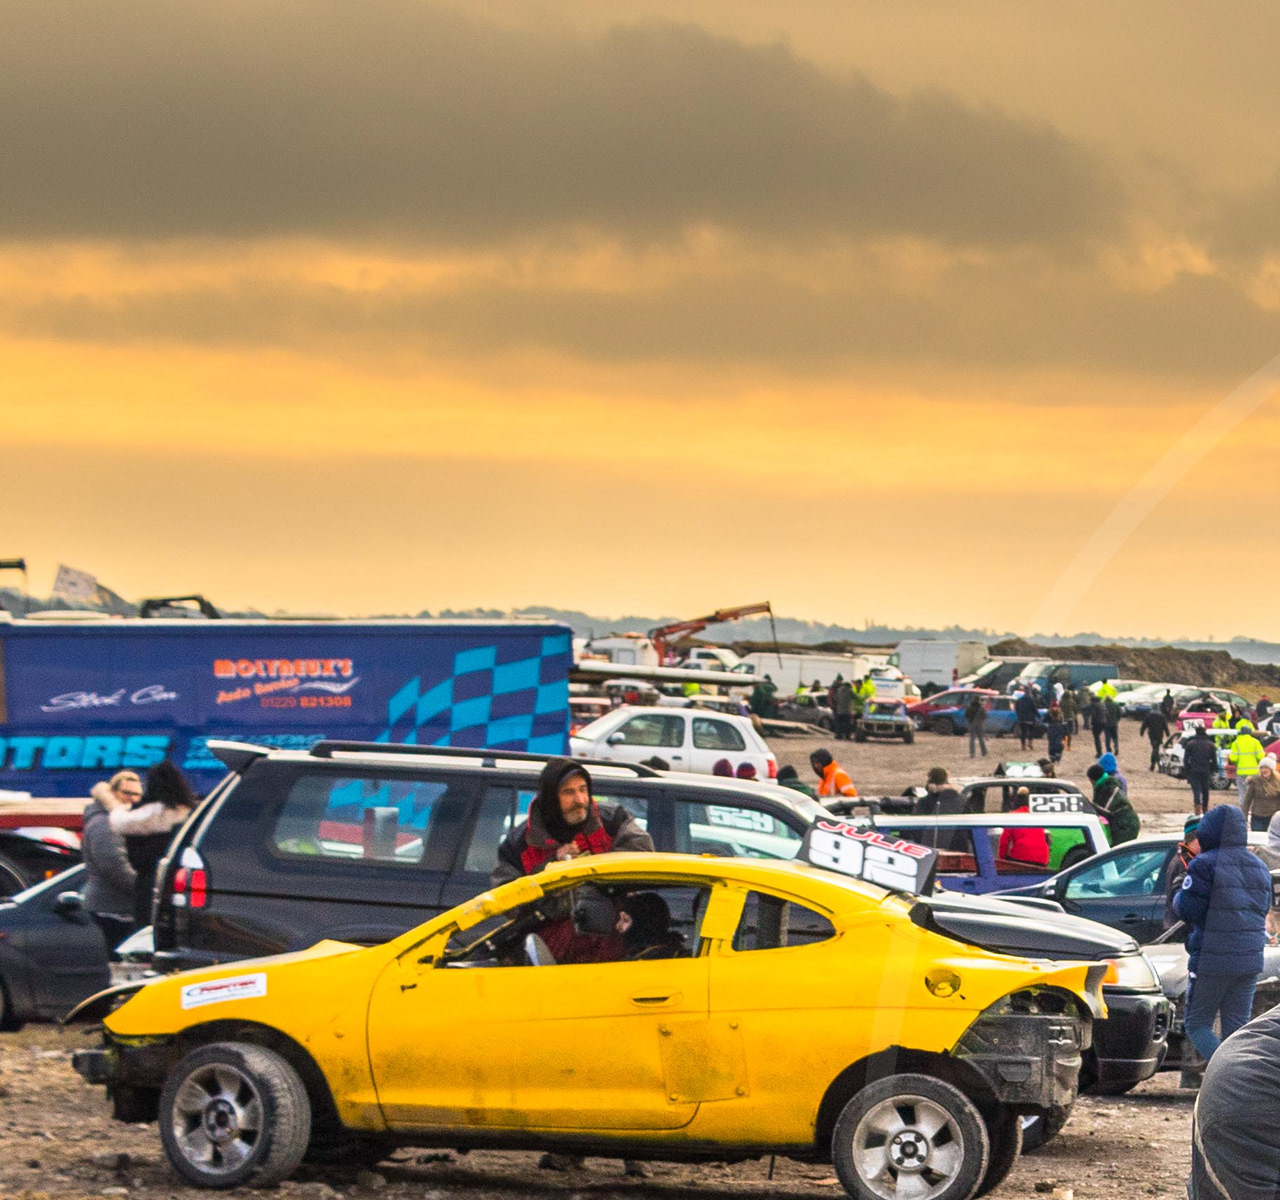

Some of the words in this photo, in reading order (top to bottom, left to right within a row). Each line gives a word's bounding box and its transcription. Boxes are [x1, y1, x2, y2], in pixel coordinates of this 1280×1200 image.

[213, 658, 353, 678] MOLYNEUX'S
[40, 688, 126, 712] Stock
[130, 685, 178, 705] Car
[0, 735, 170, 770] TORS
[1032, 796, 1083, 813] 258
[709, 805, 774, 834] 529
[816, 820, 932, 860] JULIE
[809, 829, 918, 896] 92
